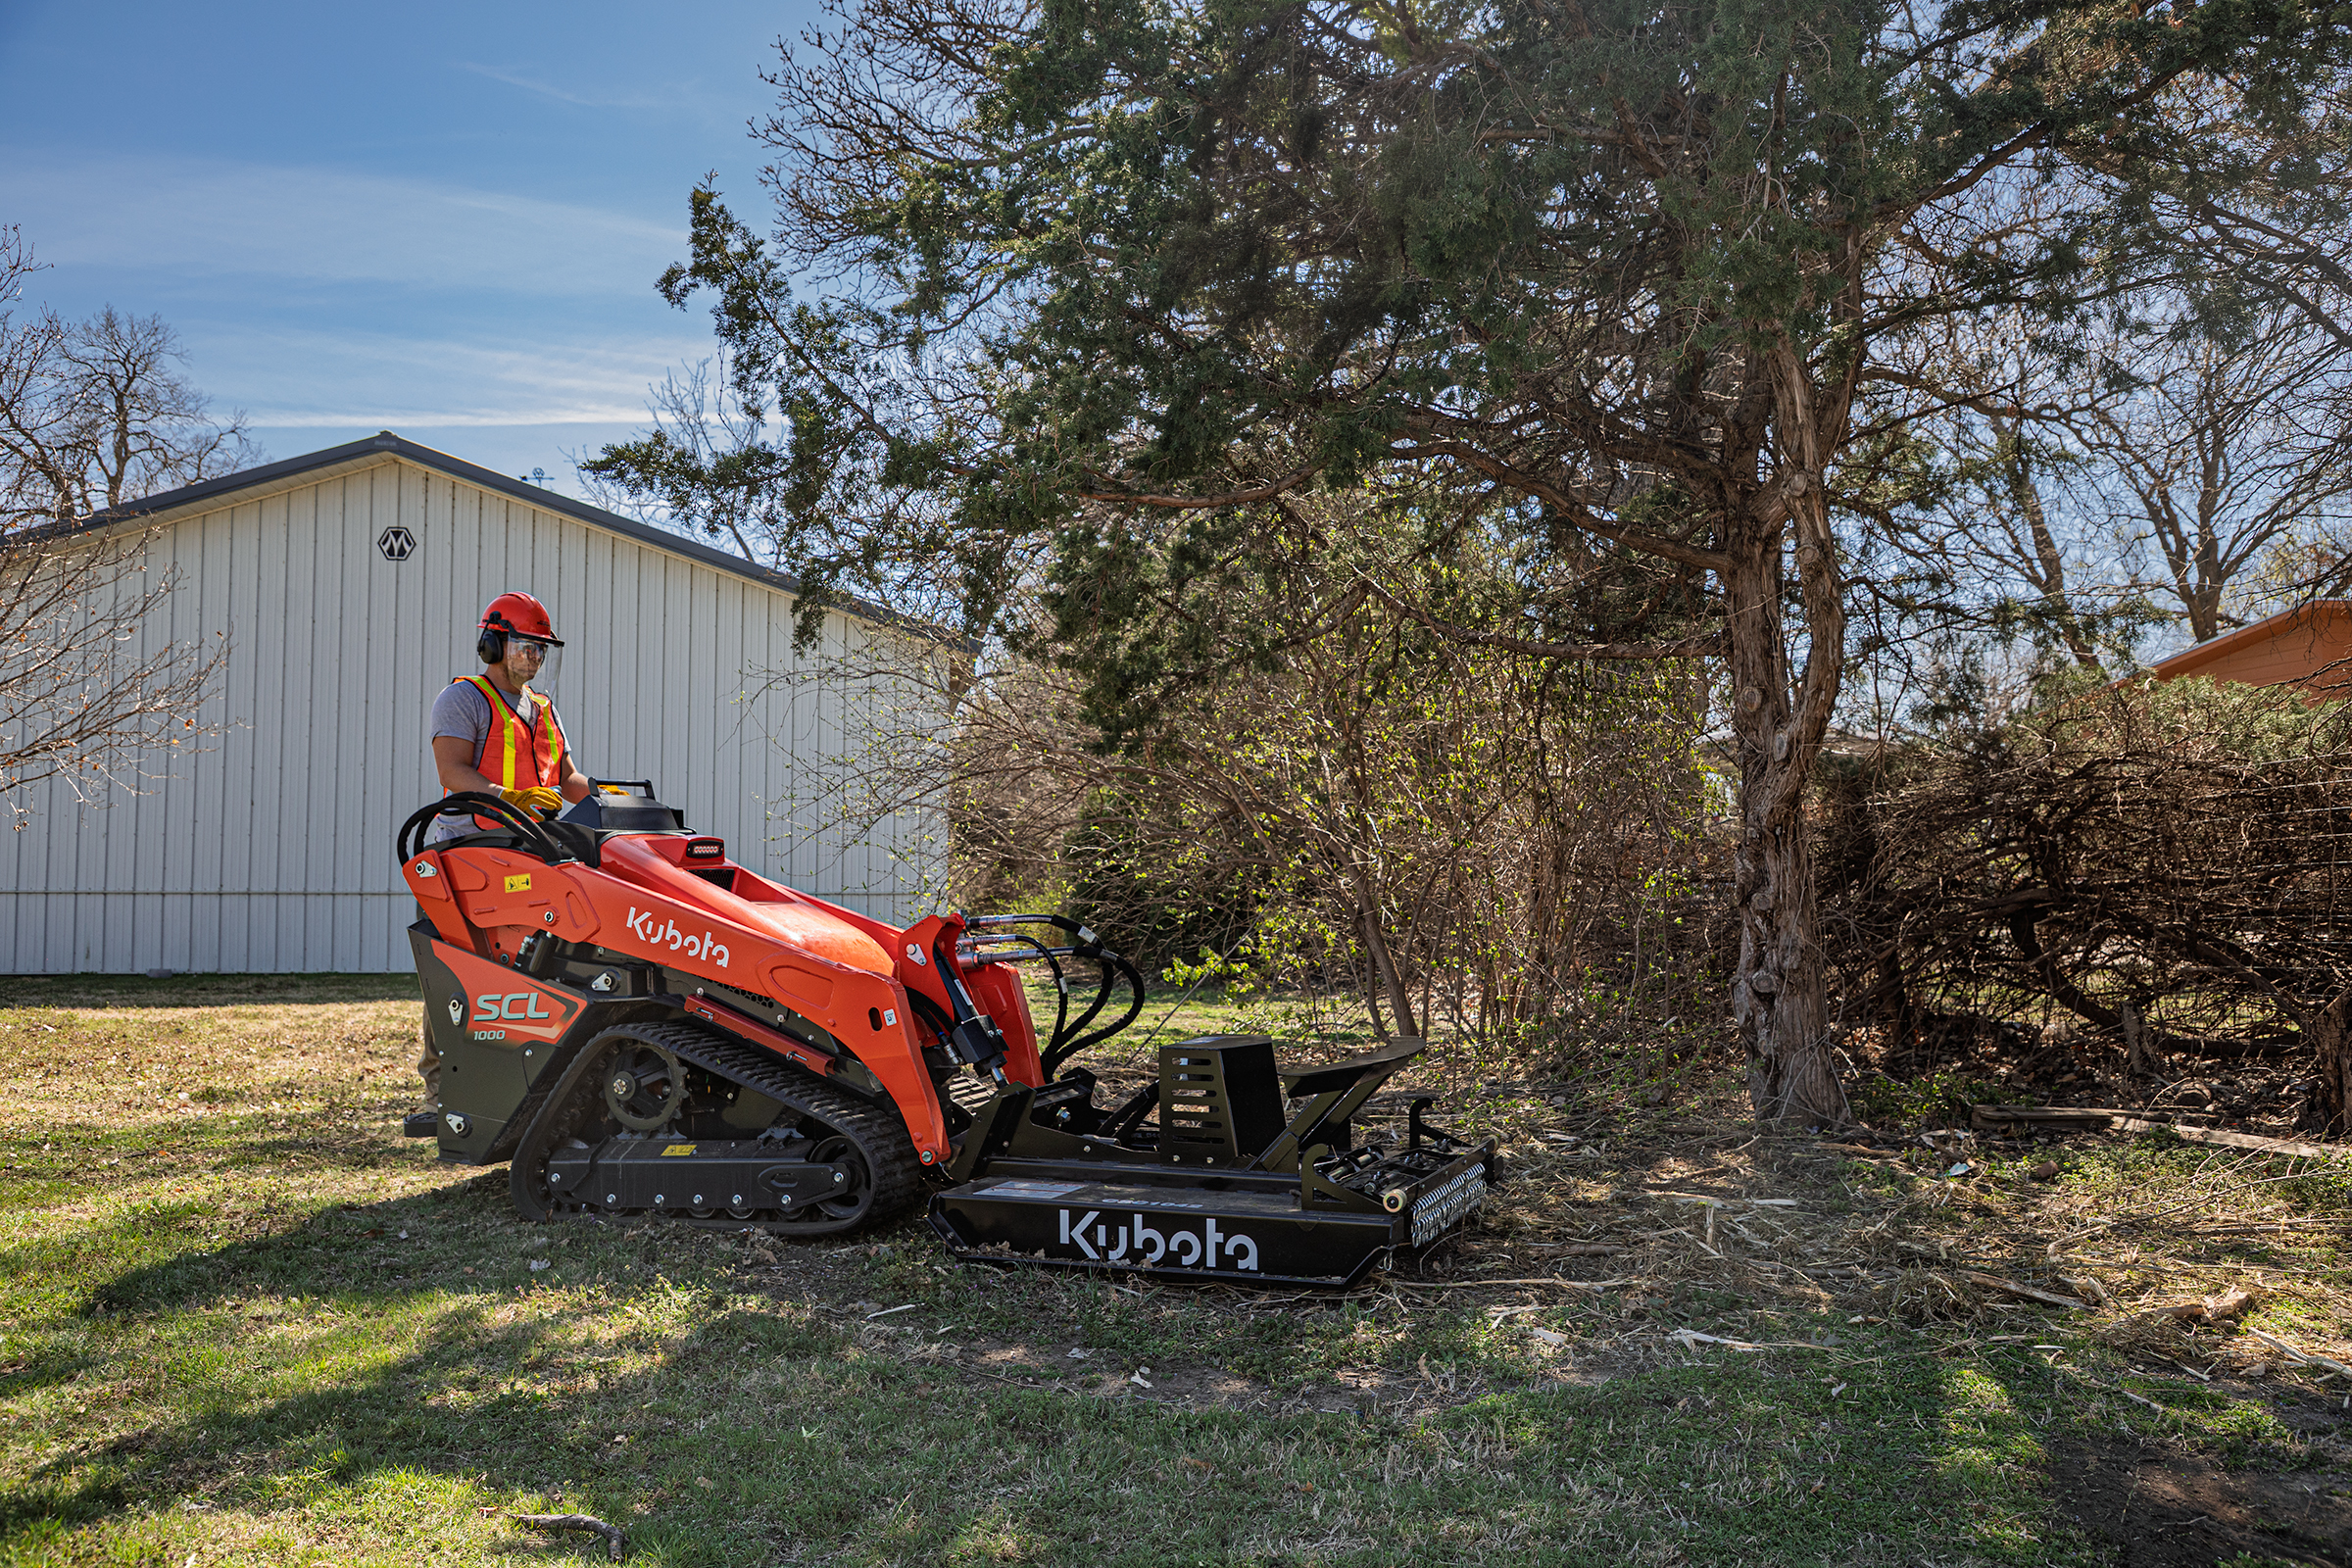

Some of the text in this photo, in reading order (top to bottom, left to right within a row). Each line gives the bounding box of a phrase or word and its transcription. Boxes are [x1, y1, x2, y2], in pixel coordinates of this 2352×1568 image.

[626, 906, 730, 968] Kubota
[473, 993, 550, 1021] SCL
[473, 1030, 506, 1041] 1000
[1059, 1208, 1258, 1271] Kubota
